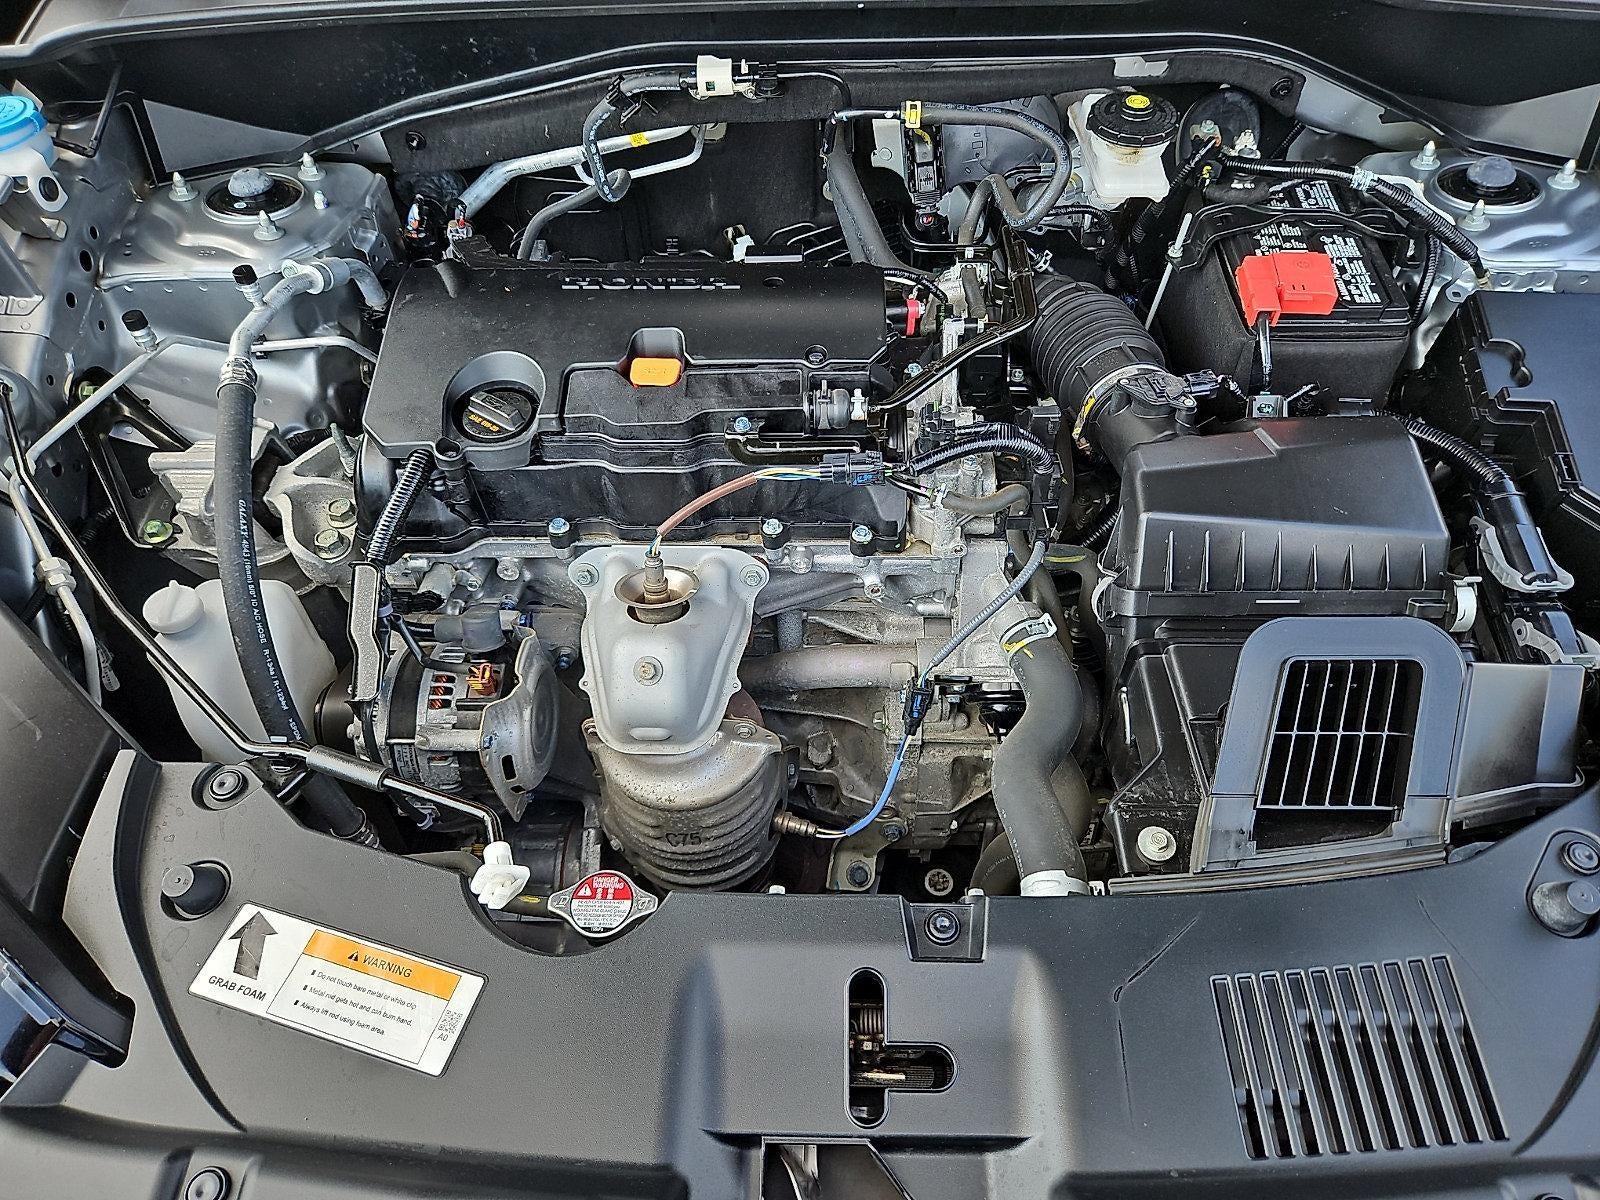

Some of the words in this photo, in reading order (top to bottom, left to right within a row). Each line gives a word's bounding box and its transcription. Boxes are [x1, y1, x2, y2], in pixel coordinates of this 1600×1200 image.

[468, 414, 482, 424] SAE
[238, 499, 249, 538] GALAXY
[241, 539, 251, 557] 4843
[250, 598, 258, 607] ID
[252, 608, 261, 621] A/C
[255, 622, 267, 644] HOSE
[262, 649, 276, 675] R-134a
[665, 832, 702, 848] C75
[362, 954, 413, 978] WARNING
[208, 976, 236, 990] GRAB
[237, 984, 266, 1001] FOAM
[317, 972, 326, 980] Do
[326, 974, 336, 984] not
[336, 977, 352, 988] touch
[353, 982, 366, 992] bare
[367, 988, 383, 998] metal
[391, 995, 406, 1006] white
[406, 1001, 416, 1010] clip
[309, 986, 325, 997] Metal
[326, 992, 335, 1000] rod
[335, 995, 348, 1006] gets
[349, 999, 359, 1008] hot
[360, 1003, 370, 1012] and
[372, 1008, 382, 1016] can
[382, 1010, 396, 1020] burn
[300, 1002, 320, 1014] Always
[329, 1010, 338, 1020] rod
[339, 1015, 356, 1026] using
[356, 1020, 371, 1030] foam
[437, 1032, 448, 1042] A0
